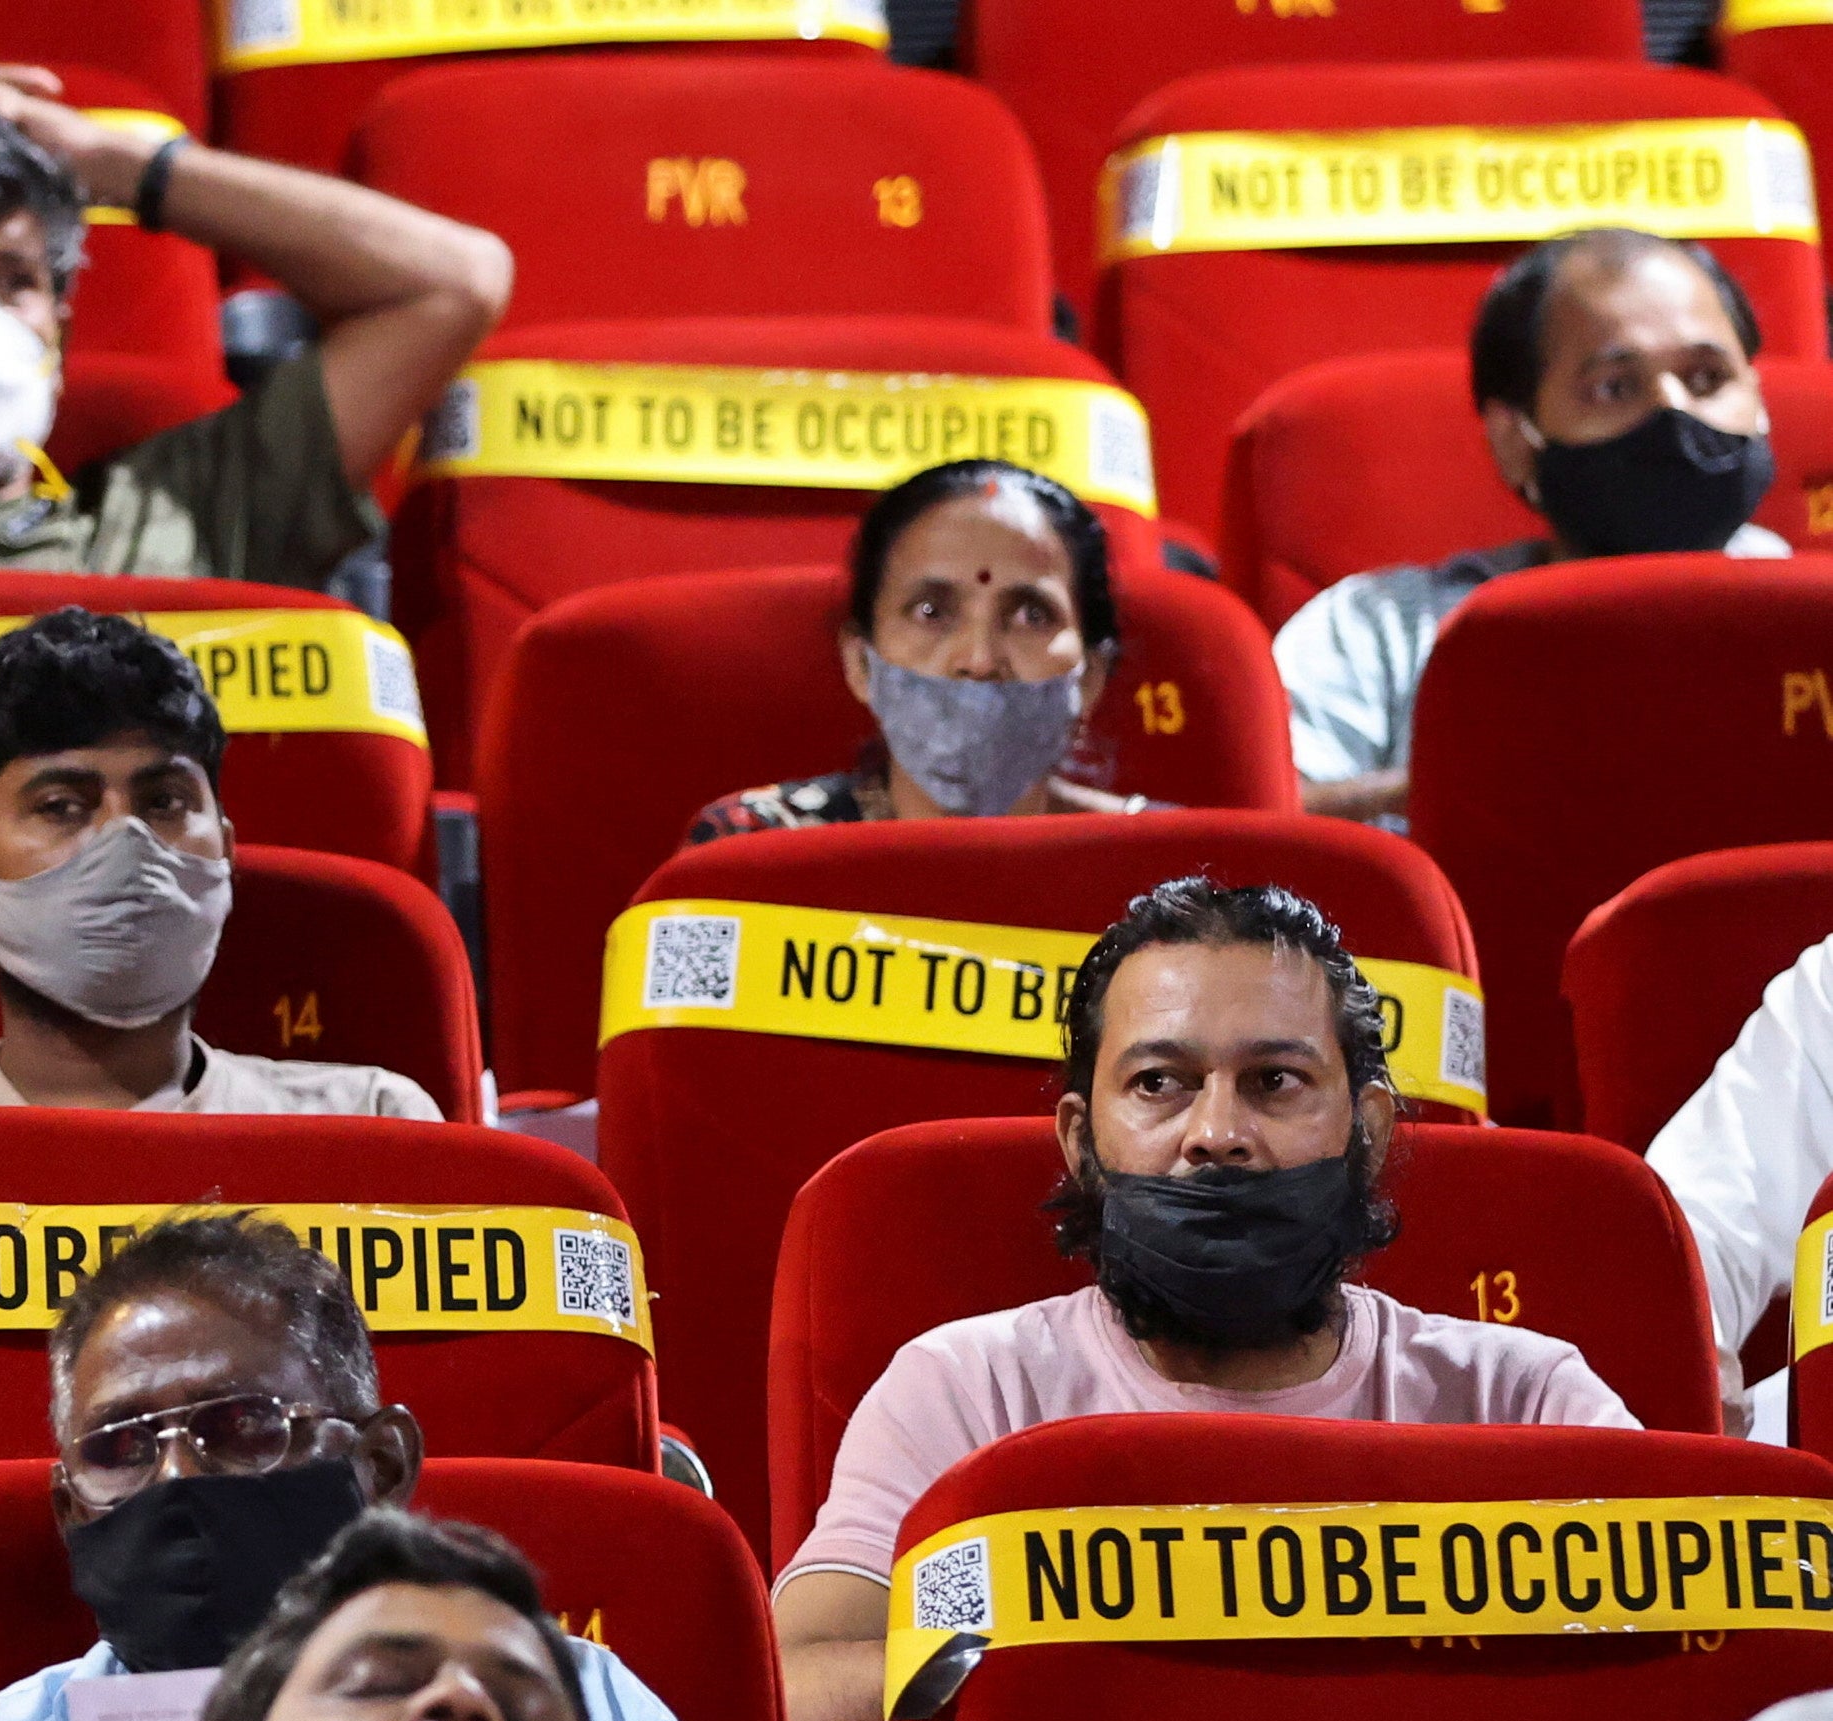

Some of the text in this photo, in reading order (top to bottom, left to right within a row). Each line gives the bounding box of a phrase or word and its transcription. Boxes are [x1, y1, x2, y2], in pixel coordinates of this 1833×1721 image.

[646, 159, 747, 227] PVR
[1212, 148, 1722, 215] NOT TO BE OCCUPIED
[515, 395, 1056, 460] NOT TO BE OCCUPIED
[211, 643, 331, 698] PIED
[1136, 684, 1185, 734] 13
[782, 940, 896, 1010] NOT
[921, 953, 984, 1014] TO
[273, 992, 323, 1048] 14
[1470, 1270, 1519, 1322] 13
[1027, 1519, 1833, 1620] NOT TO BE OCCUPIED
